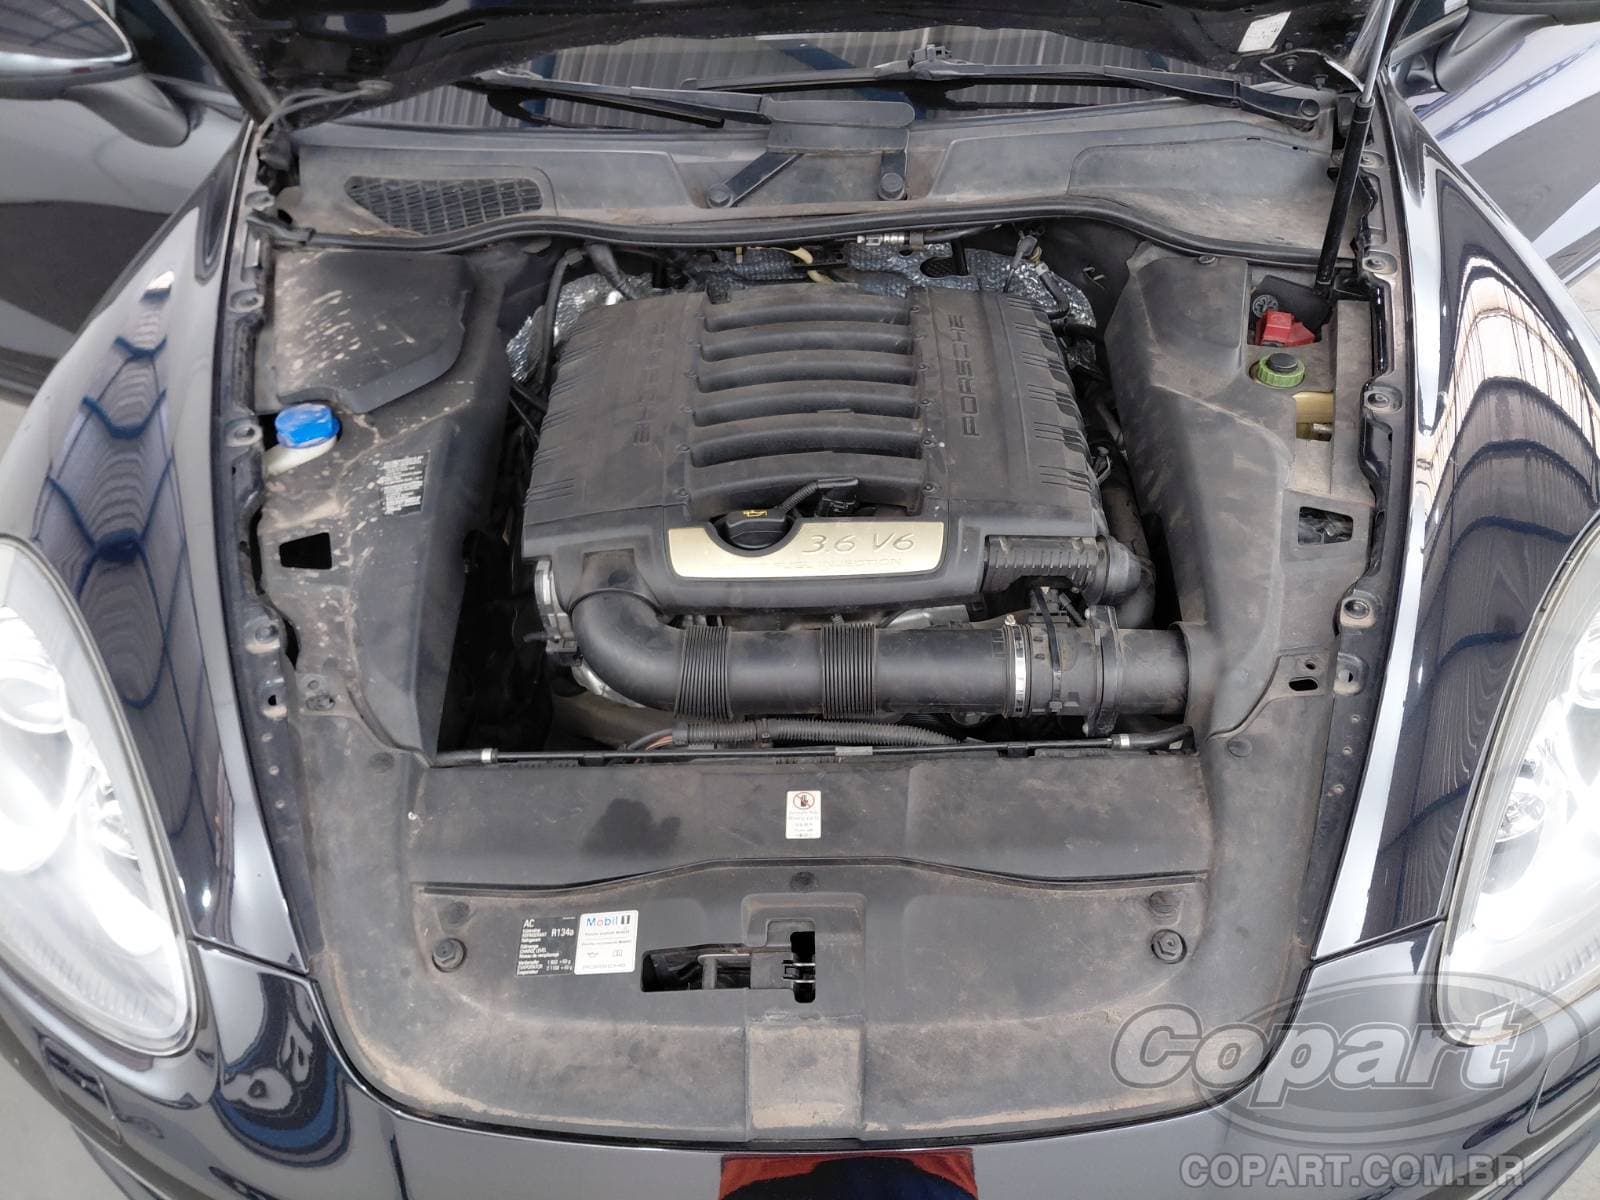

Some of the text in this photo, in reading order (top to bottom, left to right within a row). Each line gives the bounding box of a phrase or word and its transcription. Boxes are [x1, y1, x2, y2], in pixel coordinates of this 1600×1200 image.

[948, 314, 980, 437] PORSCHE
[801, 532, 916, 553] 3.6 V6
[522, 918, 536, 928] AC
[586, 915, 618, 927] Mobil
[551, 927, 575, 937] R134a
